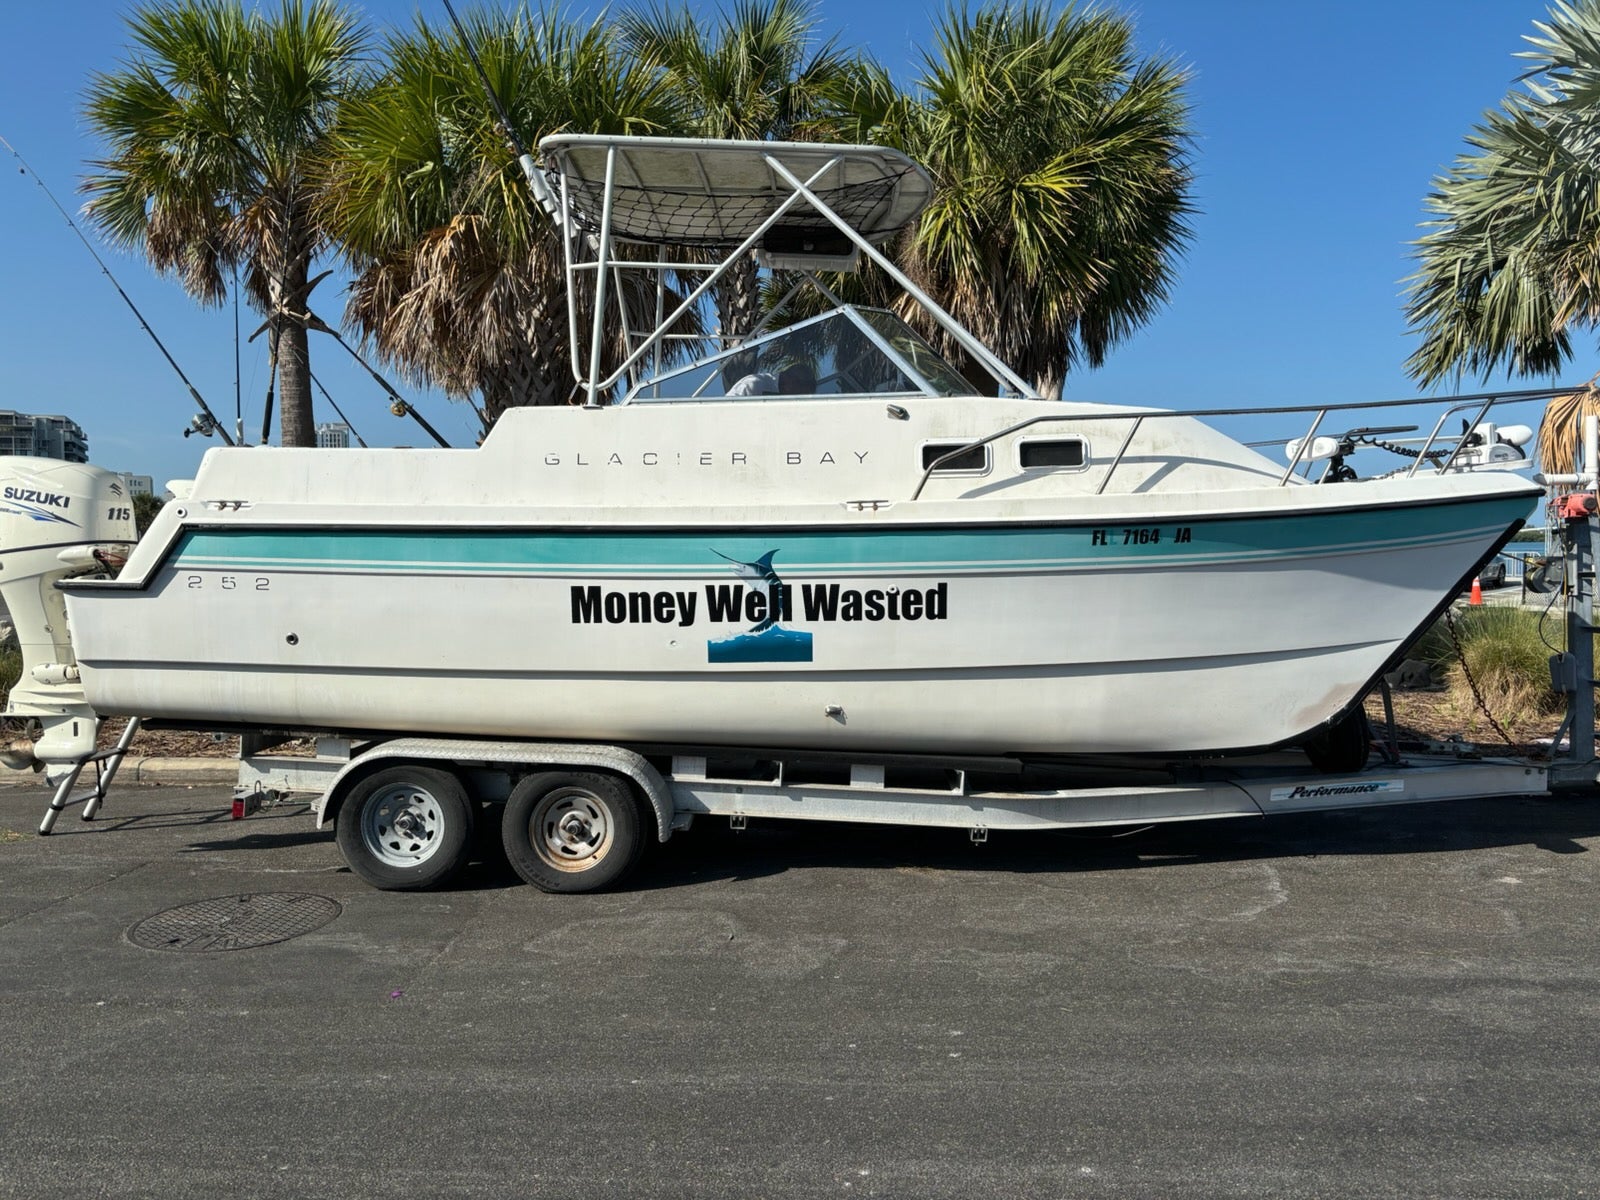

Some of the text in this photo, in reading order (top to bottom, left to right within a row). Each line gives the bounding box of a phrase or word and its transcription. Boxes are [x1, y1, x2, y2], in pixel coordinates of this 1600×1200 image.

[544, 451, 869, 466] GLACIER BAY
[3, 486, 71, 509] SUZUKI
[107, 507, 131, 521] 115
[1091, 527, 1192, 546] FL 7164 JA
[187, 575, 271, 591] 252
[570, 582, 948, 627] Money Well Wasted
[1288, 784, 1379, 799] Performance
